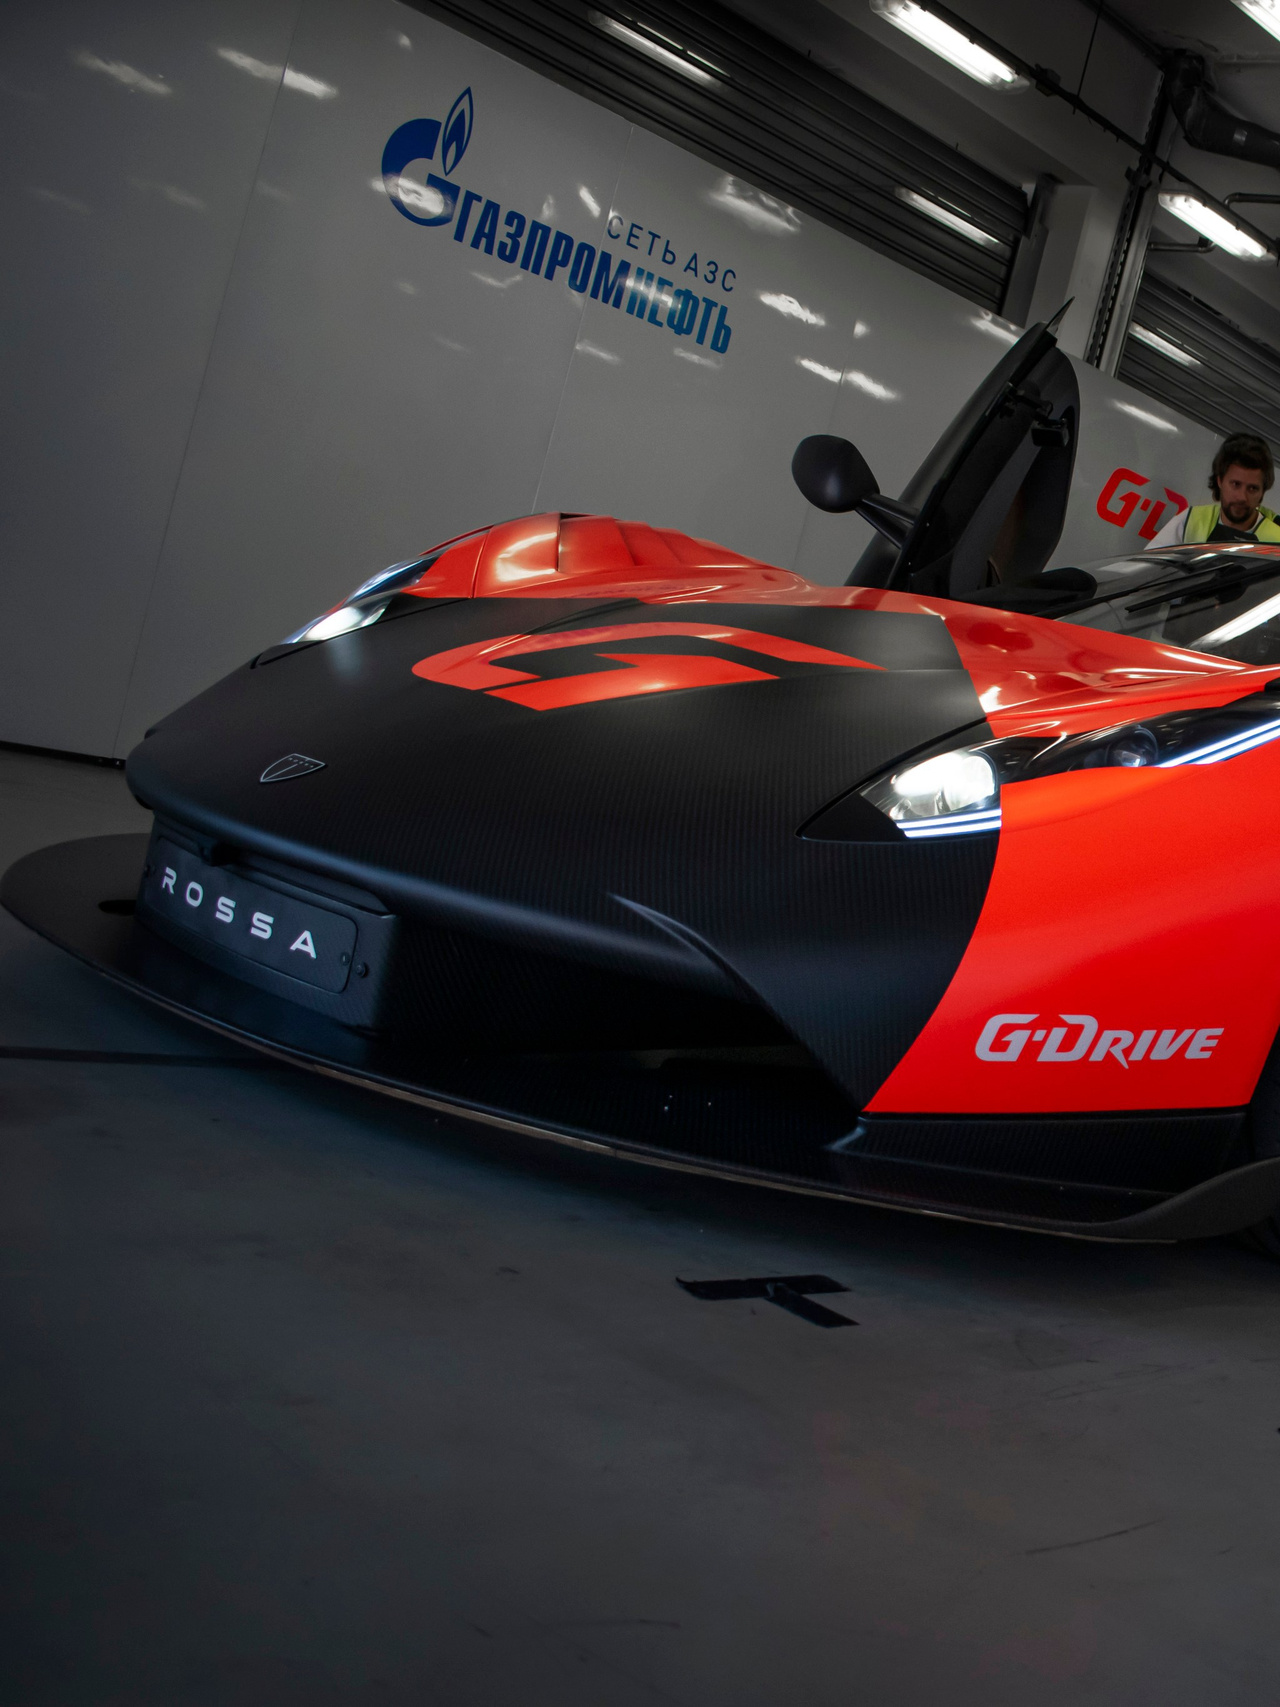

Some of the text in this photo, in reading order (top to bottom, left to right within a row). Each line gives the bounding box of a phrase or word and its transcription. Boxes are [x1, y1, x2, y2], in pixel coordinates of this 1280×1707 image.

[452, 188, 733, 355] ГАЗПРОМНЕФТЬ
[606, 214, 738, 293] СЕТЬ АЗС
[161, 866, 318, 960] ROSSA
